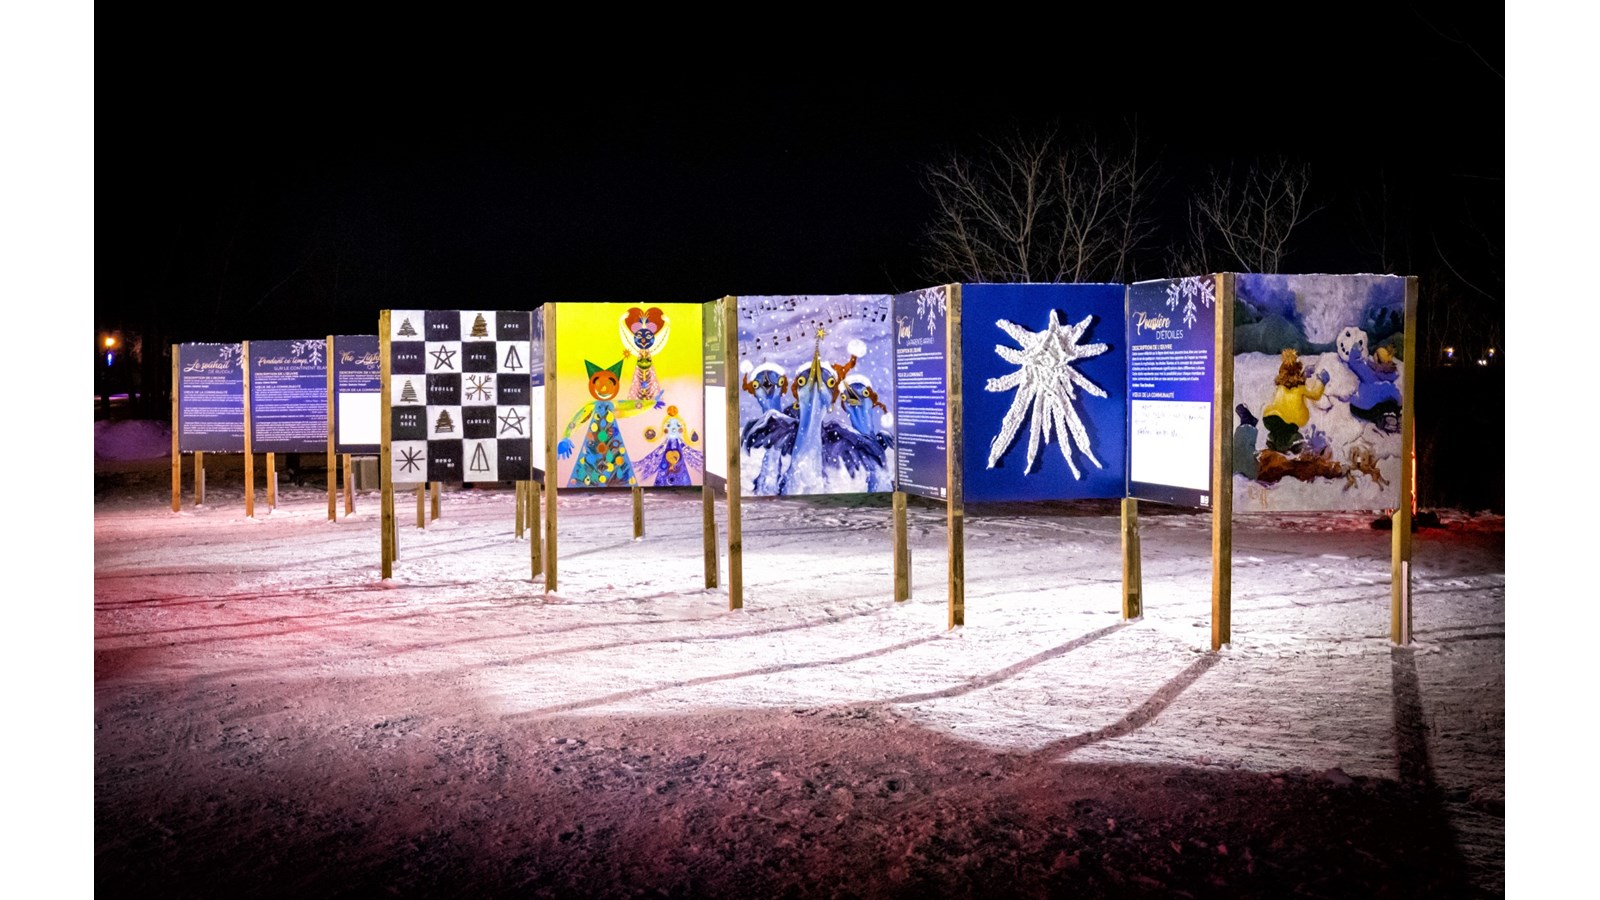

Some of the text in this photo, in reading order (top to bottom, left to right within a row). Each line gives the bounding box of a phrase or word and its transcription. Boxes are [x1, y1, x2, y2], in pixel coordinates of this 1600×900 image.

[1132, 311, 1171, 336] Poussière
[1155, 329, 1184, 340] D'ÉTOILES
[257, 356, 283, 367] Pendant
[339, 350, 355, 365] The
[471, 352, 487, 360] FÊTE
